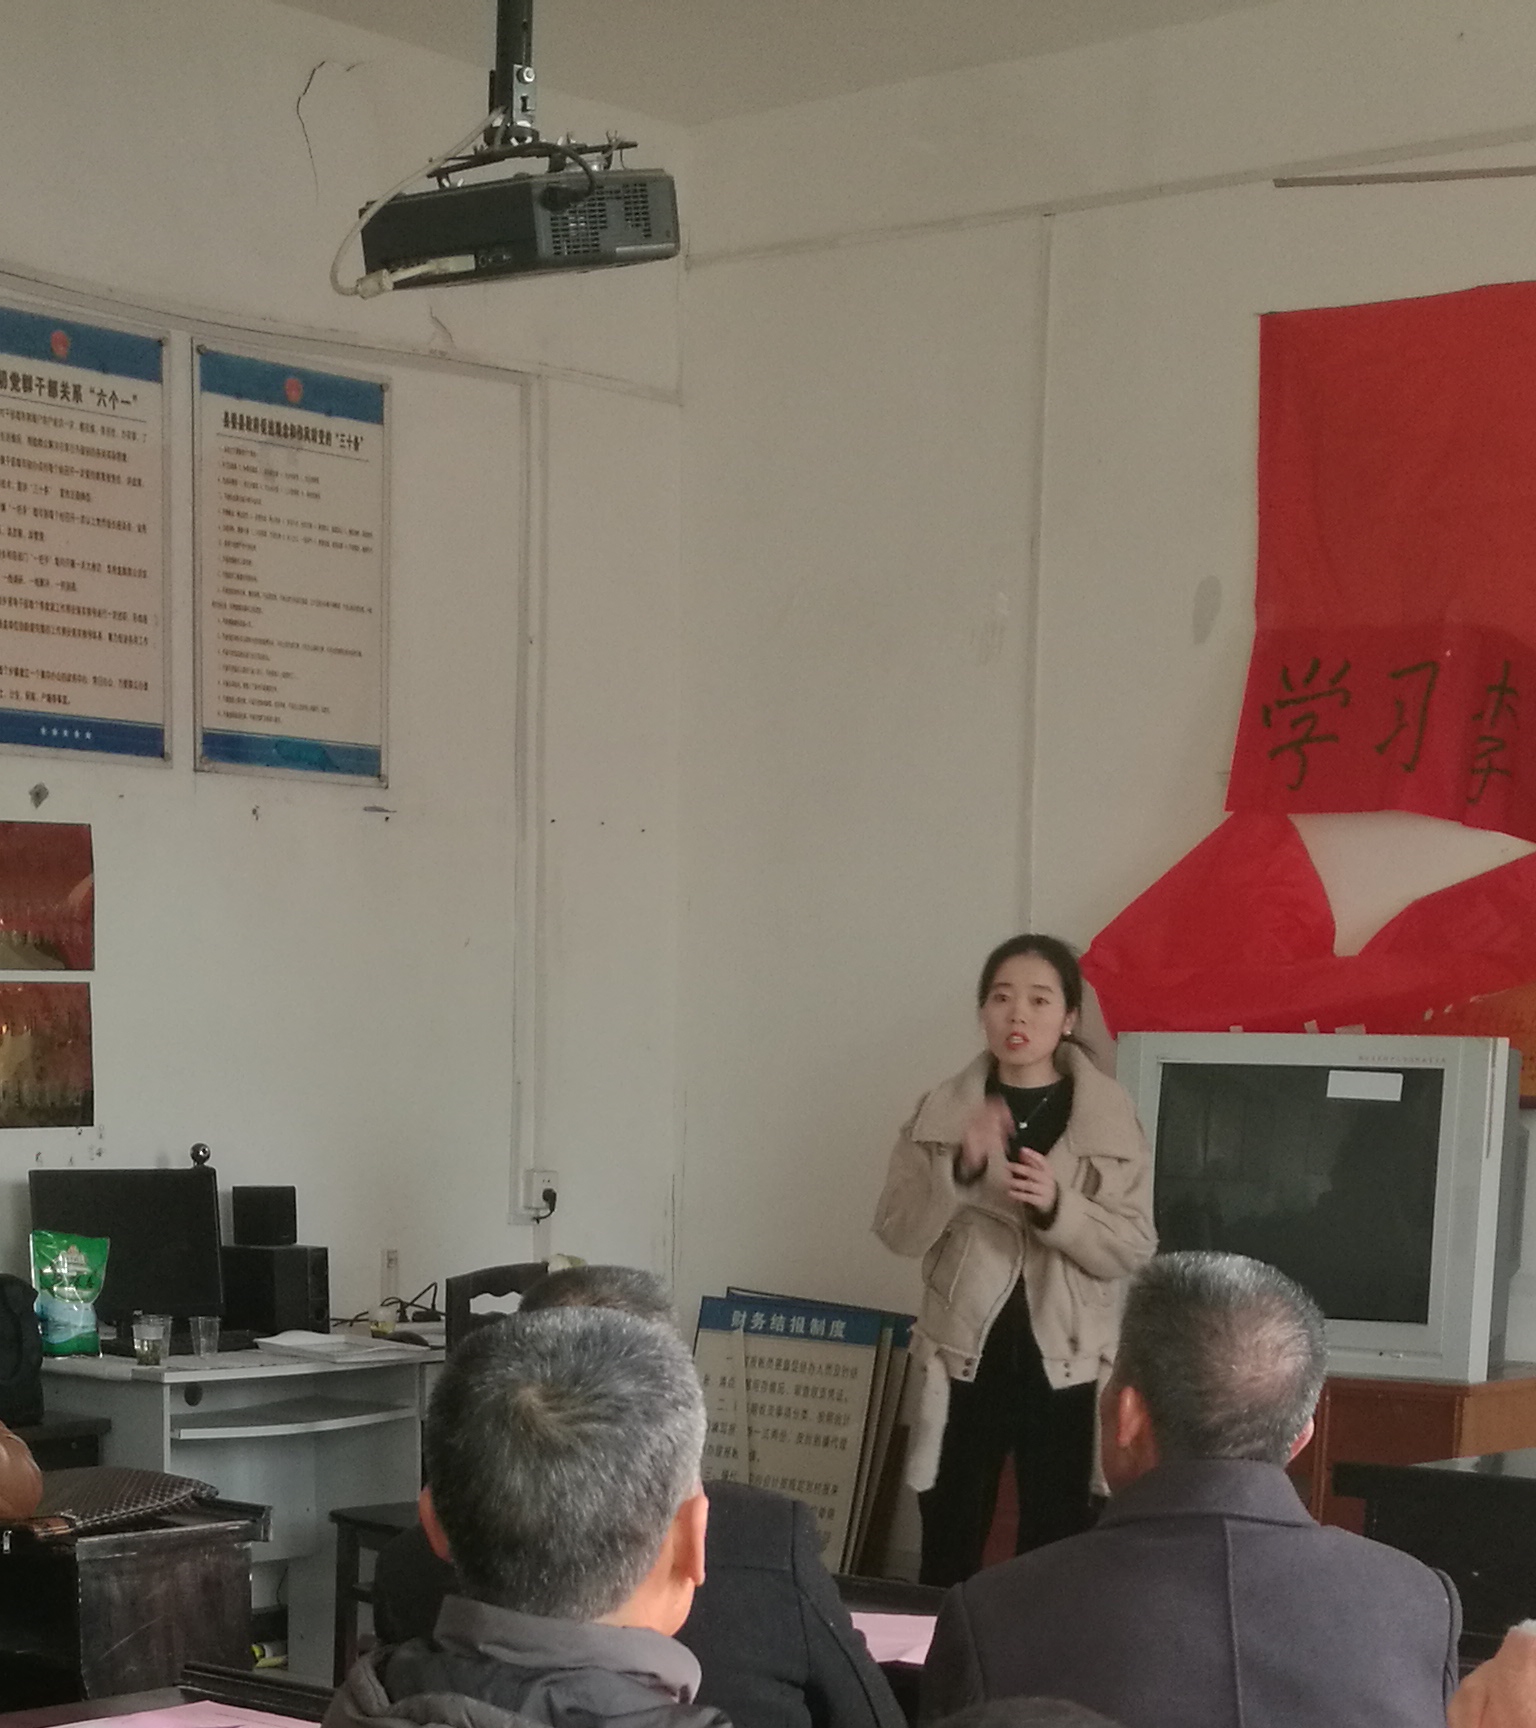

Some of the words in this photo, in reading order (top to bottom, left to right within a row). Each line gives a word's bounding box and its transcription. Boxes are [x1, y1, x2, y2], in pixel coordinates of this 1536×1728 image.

[730, 1309, 848, 1340] 财务结报制度
